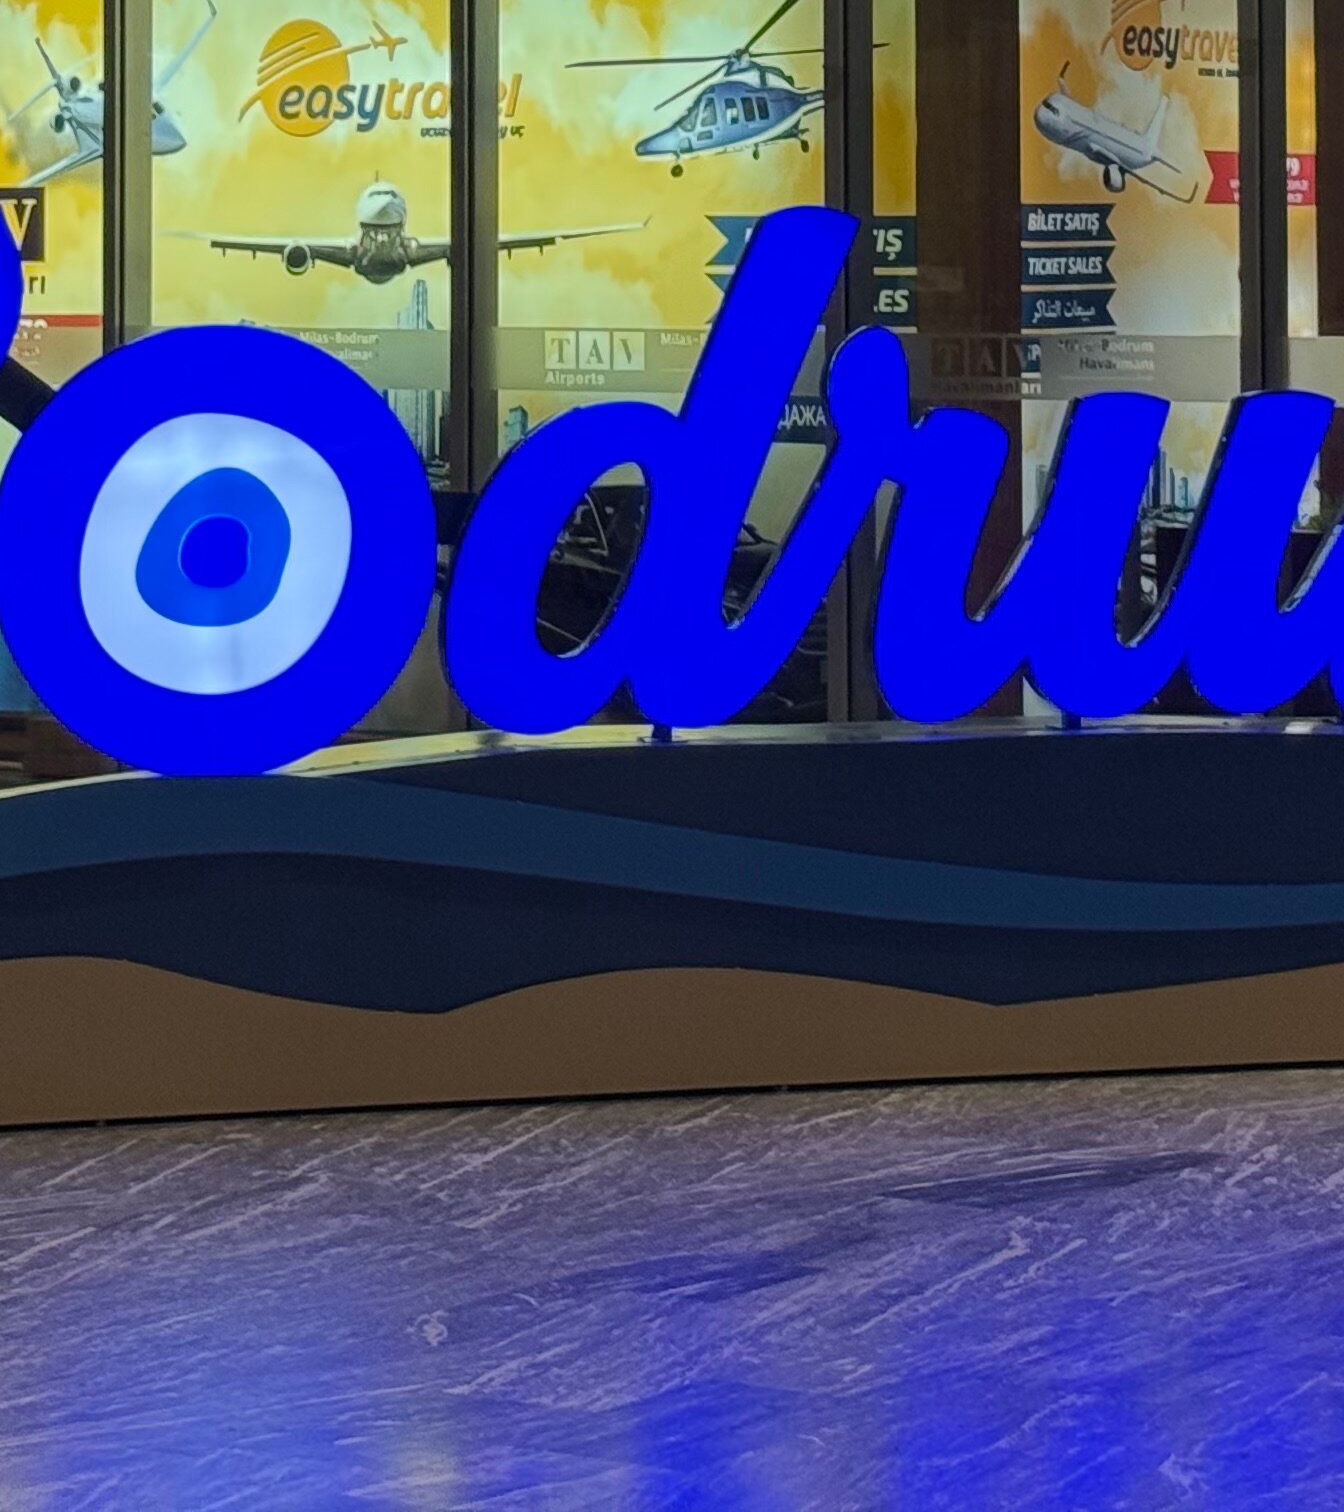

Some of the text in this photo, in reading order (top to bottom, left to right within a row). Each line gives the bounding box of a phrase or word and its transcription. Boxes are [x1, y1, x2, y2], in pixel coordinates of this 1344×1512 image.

[1123, 24, 1238, 69] easytrave
[1027, 208, 1100, 236] BİLET SATIŞ
[1028, 256, 1102, 276] TICKET SALES
[545, 371, 605, 386] Airports
